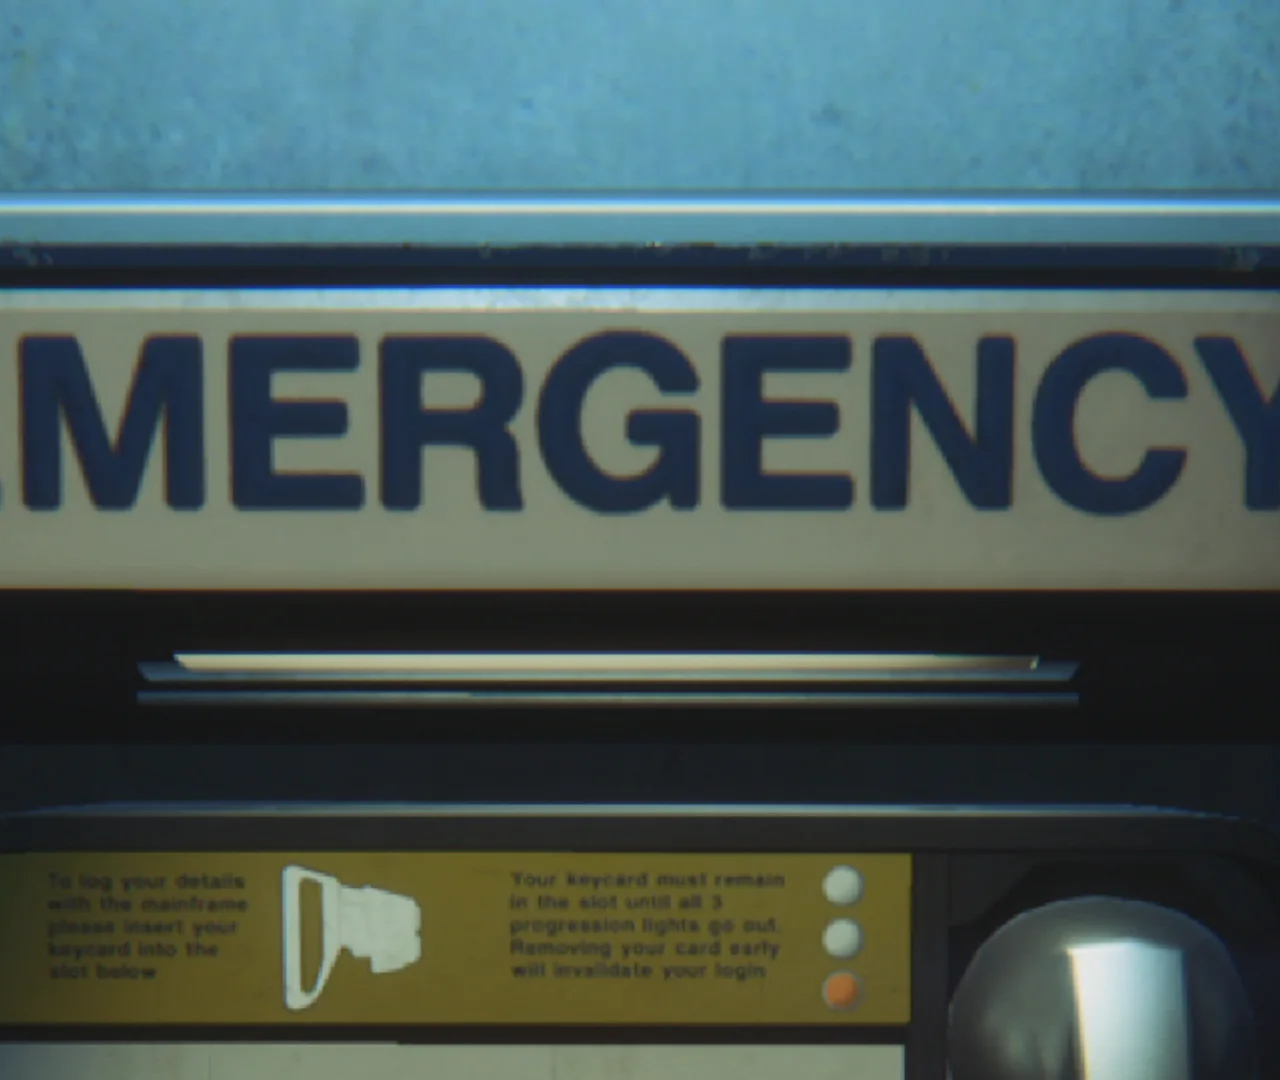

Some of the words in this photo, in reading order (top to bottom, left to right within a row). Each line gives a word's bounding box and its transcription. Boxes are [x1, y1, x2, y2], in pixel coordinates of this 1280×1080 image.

[48, 872, 72, 890] To
[79, 872, 113, 892] log
[120, 876, 166, 892] your
[175, 872, 247, 890] details
[510, 872, 556, 888] Your
[566, 872, 648, 890] keycard
[657, 872, 706, 888] must
[714, 874, 785, 888] remain
[48, 896, 91, 912] with
[100, 896, 131, 912] the
[141, 896, 248, 912] mainframe
[509, 894, 529, 911] in
[538, 894, 569, 911] the
[579, 894, 618, 911] slot
[625, 894, 671, 911] until
[678, 894, 703, 911] all
[47, 919, 114, 937] please
[124, 919, 184, 934] insert
[192, 921, 237, 938] your
[510, 918, 634, 937] progression
[641, 918, 700, 937] lights
[707, 919, 734, 937] go
[47, 941, 131, 960] keycard
[138, 941, 177, 957] into
[185, 941, 218, 957] the
[509, 938, 612, 960] Removing
[620, 942, 665, 960] your
[675, 941, 720, 956] card
[729, 941, 781, 961] early
[49, 964, 88, 980] slot
[95, 964, 157, 980] below
[510, 962, 546, 978] will
[552, 962, 653, 978] invalidate
[660, 964, 707, 981] your
[714, 962, 767, 982] login
